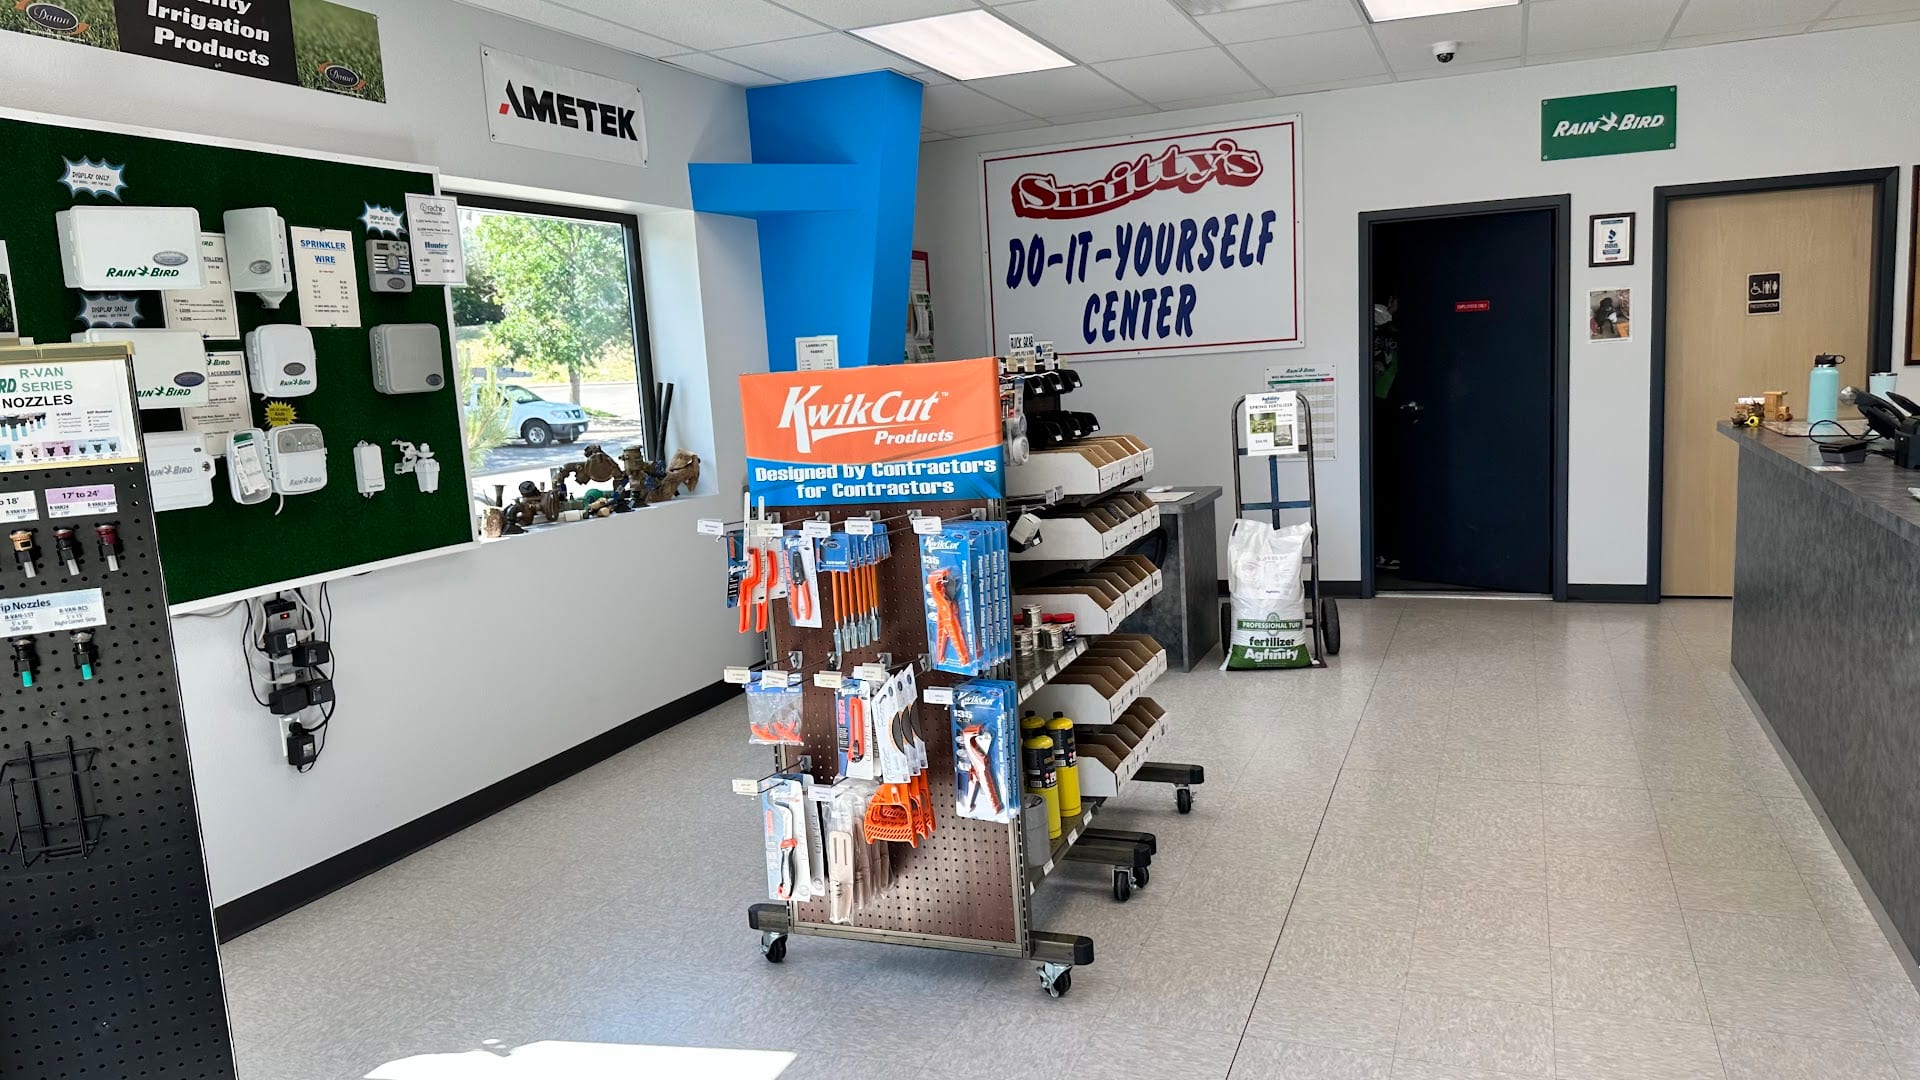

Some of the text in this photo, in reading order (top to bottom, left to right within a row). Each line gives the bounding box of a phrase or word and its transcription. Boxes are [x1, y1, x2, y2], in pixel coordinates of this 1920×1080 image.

[147, 0, 270, 42] Irrigation
[153, 26, 270, 67] Products
[499, 79, 638, 141] AMETEK
[1552, 113, 1665, 137] RAIN BIRD
[72, 171, 110, 182] DISPLAY ONLY
[1011, 138, 1264, 220] Smitty's
[300, 239, 346, 250] SPRINKLER
[424, 241, 449, 249] Hunter
[1006, 209, 1277, 290] DO-IT-YOURSELF
[314, 255, 336, 264] WIRE
[106, 267, 180, 278] RAIN BIRD
[91, 306, 112, 314] DISPLAY
[1082, 284, 1197, 345] CENTER
[19, 366, 64, 379] R-VAN
[21, 379, 73, 393] SERIES
[137, 387, 191, 398] AIN BIRD
[2, 394, 73, 409] NOZZLES
[777, 384, 941, 454] KwikCut
[873, 429, 954, 446] Products
[150, 465, 192, 477] AIN BIRD
[754, 458, 997, 482] Designed by Contractors
[62, 491, 74, 500] 17'
[796, 479, 955, 499] for Contractors
[924, 535, 960, 553] KwikCut
[922, 556, 940, 565] 135
[12, 600, 51, 610] Nozzles
[1242, 620, 1287, 629] PROFESSIONAL
[1249, 636, 1296, 647] fertilizer
[1244, 648, 1298, 662] Agfinity
[952, 710, 973, 718] 135
